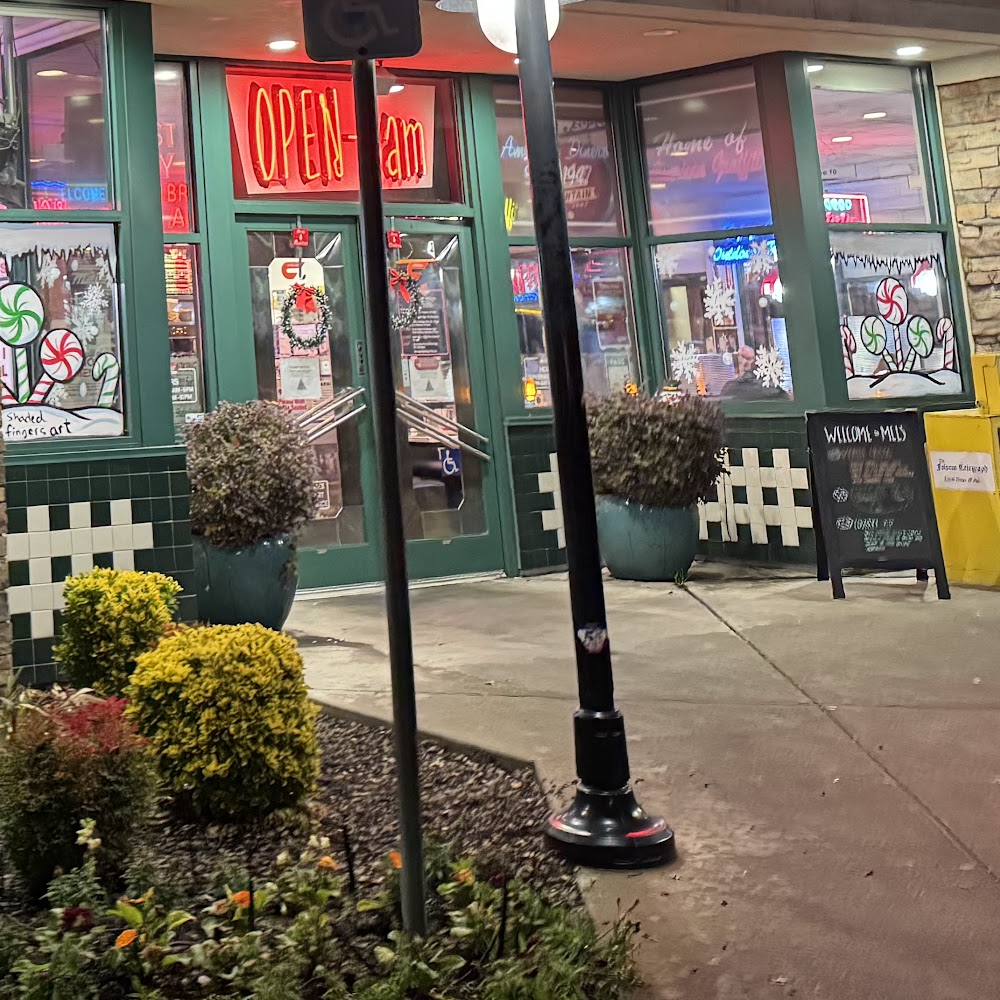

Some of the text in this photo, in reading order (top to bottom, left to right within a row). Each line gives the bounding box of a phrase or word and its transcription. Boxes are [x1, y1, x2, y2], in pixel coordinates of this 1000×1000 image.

[724, 121, 747, 153] of
[5, 418, 72, 439] fingers art
[824, 425, 873, 444] WELCOME
